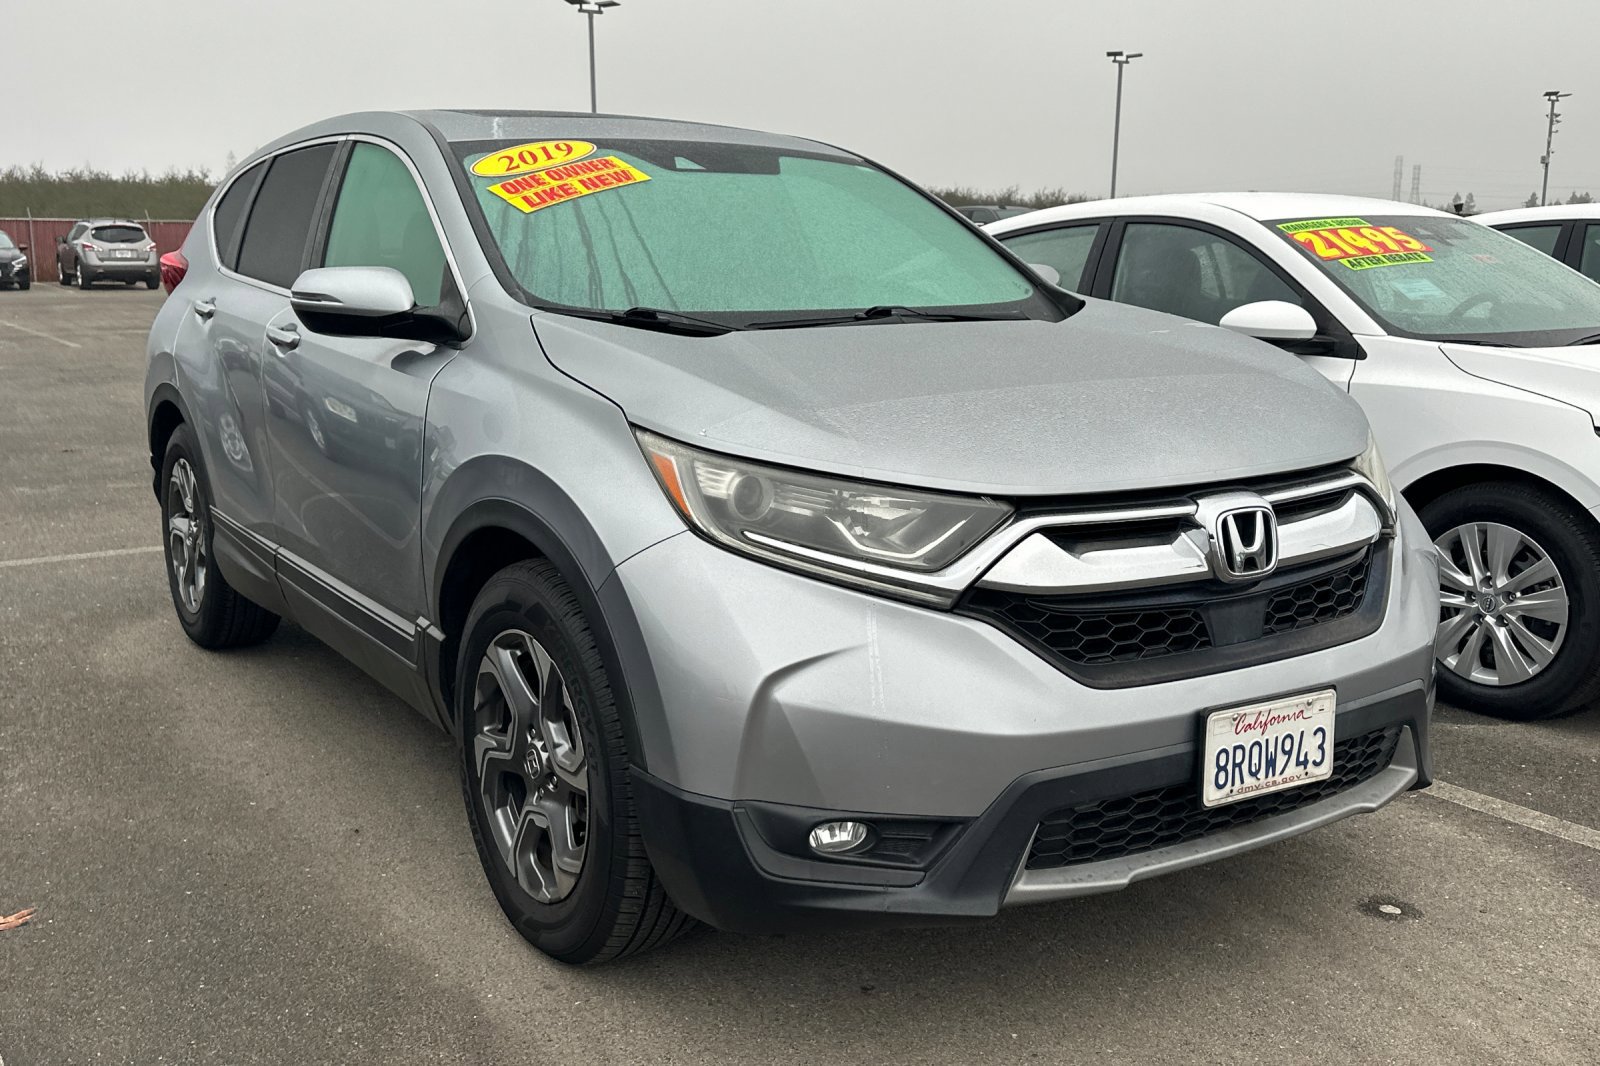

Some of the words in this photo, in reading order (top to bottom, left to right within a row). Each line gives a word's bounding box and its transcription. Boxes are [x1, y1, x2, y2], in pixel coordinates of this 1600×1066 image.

[497, 142, 574, 172] 2019
[500, 173, 546, 195] ONE
[544, 157, 617, 183] OWNER
[521, 183, 580, 208] LIKE
[578, 168, 634, 191] NEW
[1294, 227, 1427, 257] 21495
[1346, 254, 1387, 269] AFTER
[1383, 251, 1429, 263] REBATE
[1234, 708, 1312, 736] California
[1214, 726, 1327, 790] 8RQW943
[1237, 773, 1302, 793] dmv.ca.gov
